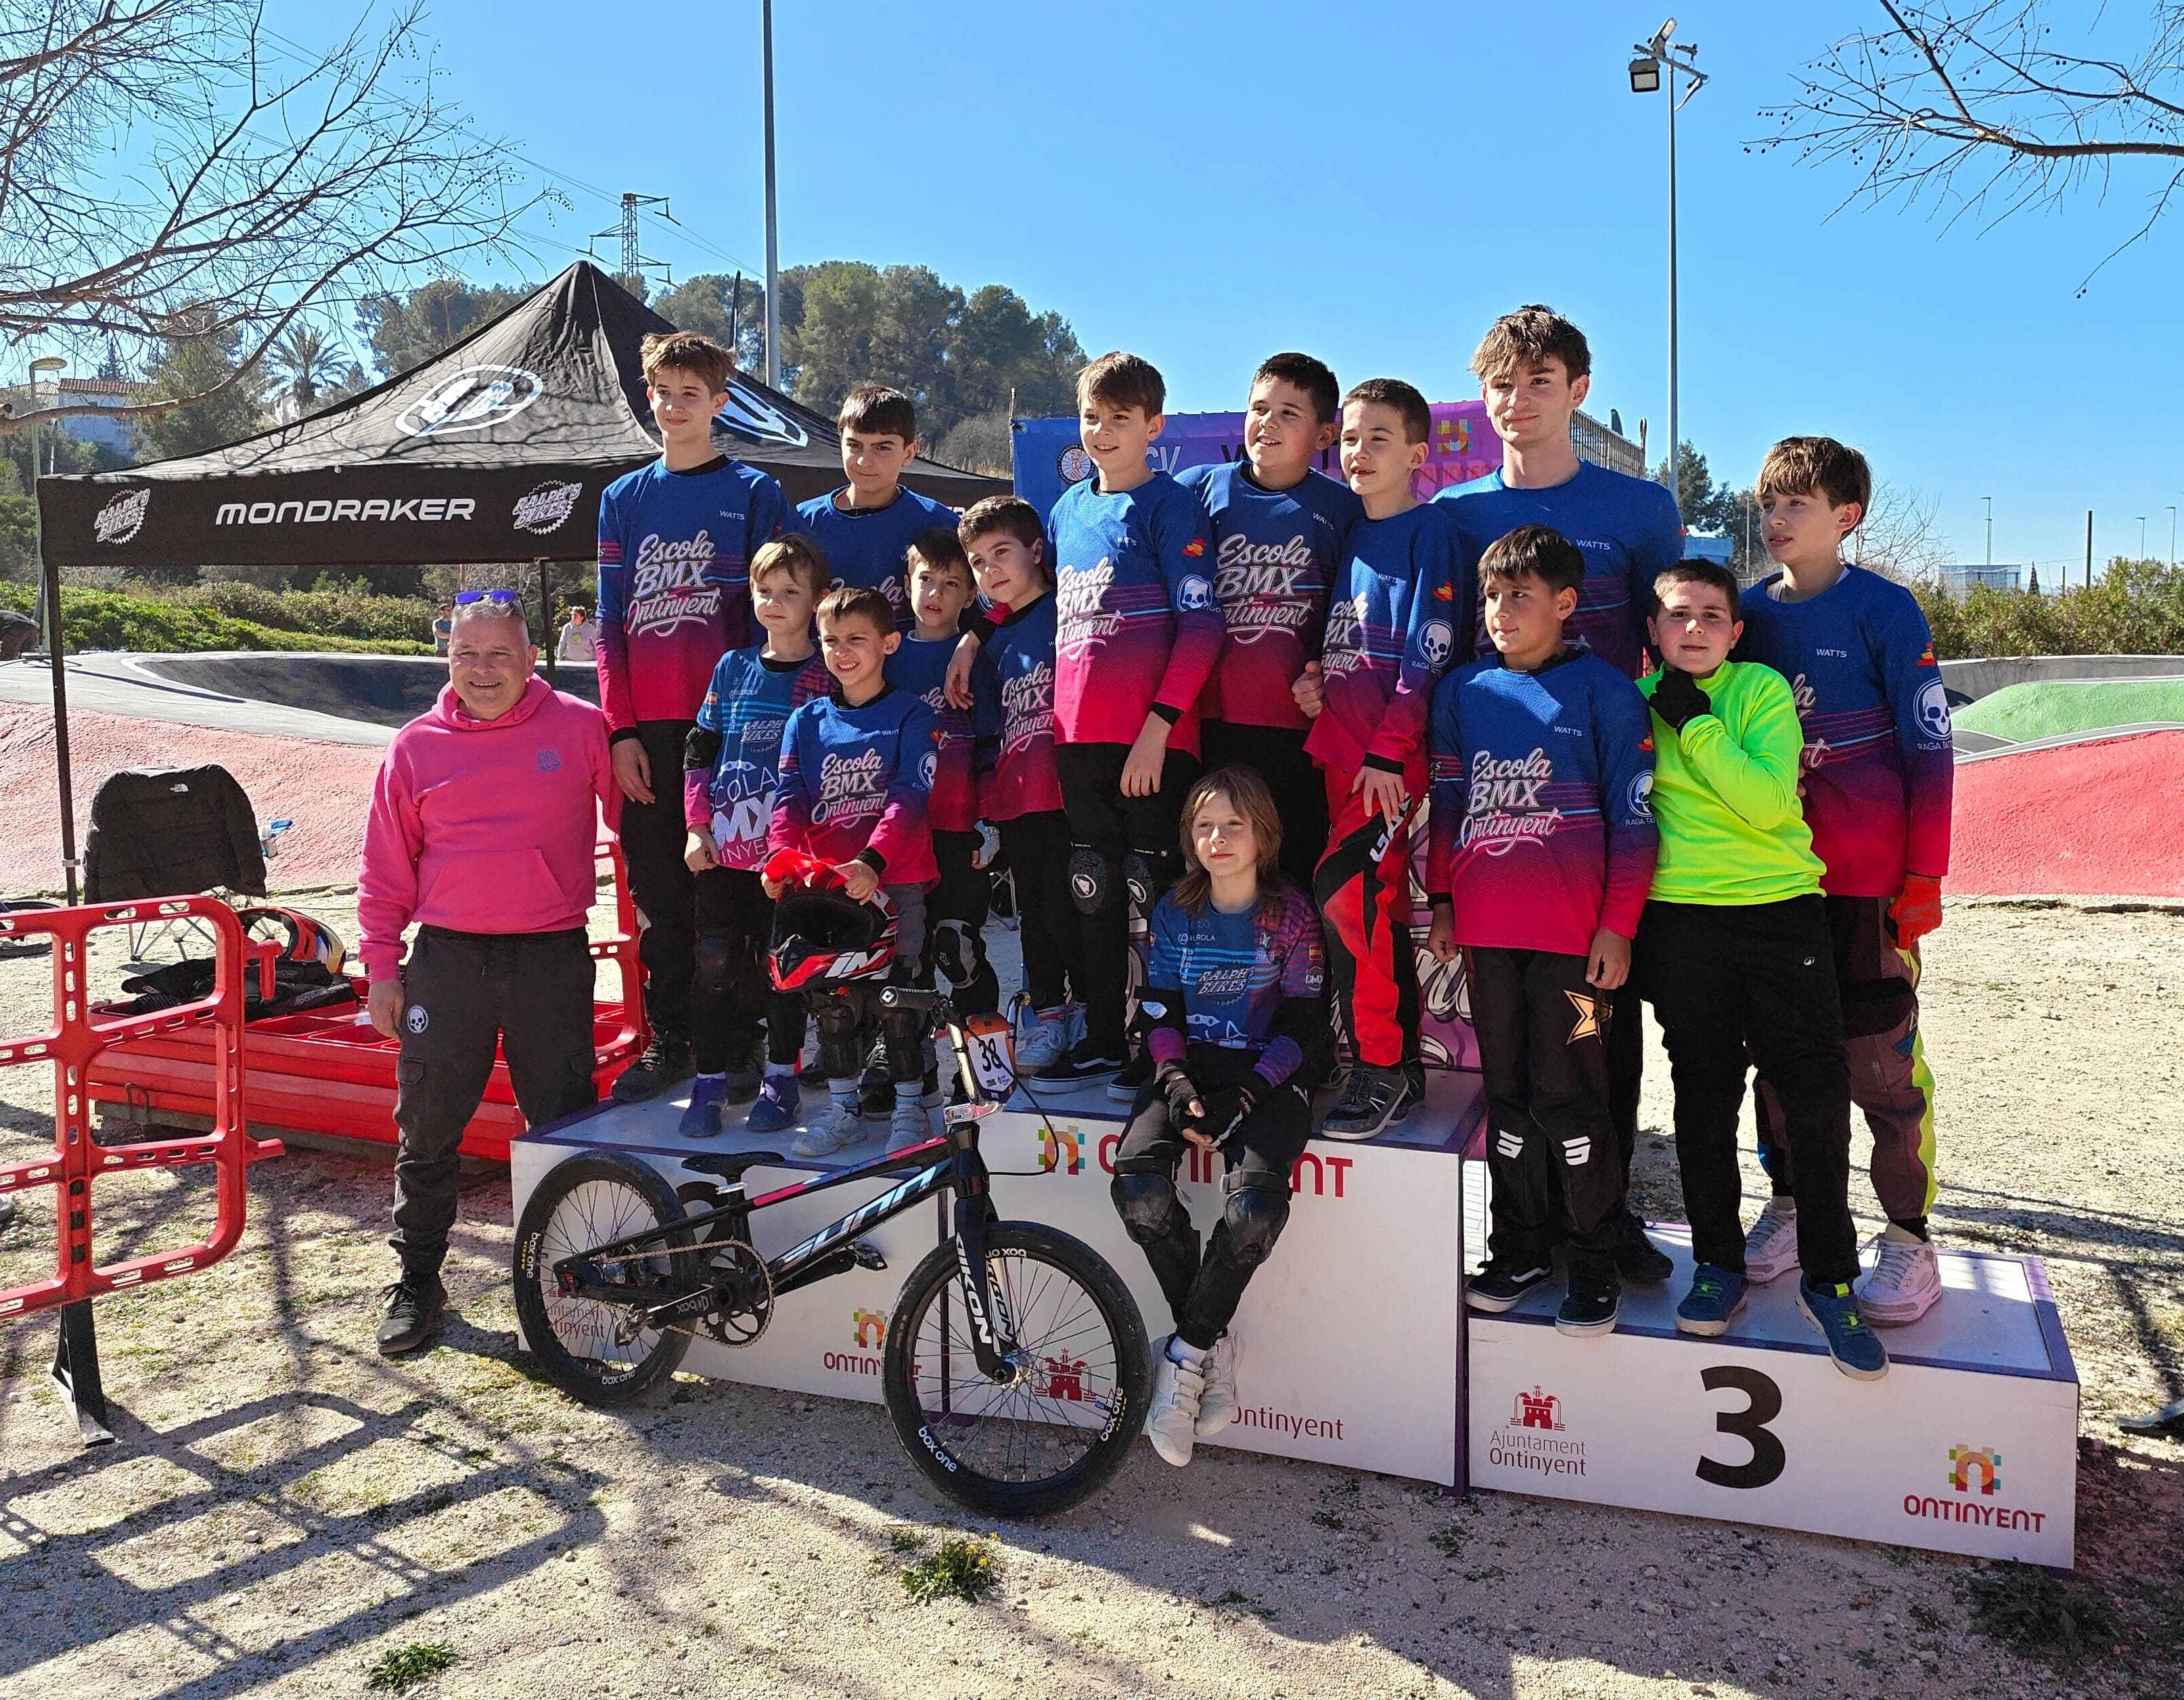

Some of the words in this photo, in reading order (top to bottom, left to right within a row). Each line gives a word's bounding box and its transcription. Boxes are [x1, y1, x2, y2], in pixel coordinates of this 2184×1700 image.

[215, 498, 476, 525] MONDRAKER
[512, 483, 583, 516] RALPH'S
[720, 510, 745, 520] WATTS
[514, 506, 570, 529] BIKES
[635, 529, 716, 570] Escola
[1216, 533, 1313, 569] Escola
[1576, 539, 1611, 551] WATTS
[633, 560, 711, 598] BMX
[1213, 565, 1307, 598] BMX
[627, 587, 722, 638] Ontinyent
[1055, 585, 1112, 619] BMX
[1816, 648, 1847, 658] WATTS
[1001, 661, 1054, 707] Escola
[1554, 725, 1583, 737] WATTS
[1917, 742, 1942, 751] RAGA
[820, 748, 884, 780] Escola
[1471, 747, 1553, 784] Escola
[819, 770, 882, 800] BMX
[1468, 780, 1550, 814] BMX
[811, 788, 889, 829] Ontinyent
[1625, 817, 1645, 826] RAGA
[1460, 807, 1564, 856] Ontinyent
[1196, 979, 1248, 996] BIKES
[978, 1037, 1002, 1072] 38
[528, 1232, 541, 1256] box
[1001, 1247, 1027, 1258] box
[526, 1256, 536, 1279] one
[601, 1374, 621, 1386] box
[620, 1368, 636, 1381] one
[1112, 1387, 1124, 1415] one
[1490, 1429, 1587, 1456] Ajuntament
[1696, 1366, 1786, 1489] 3
[918, 1425, 939, 1454] box
[935, 1450, 958, 1473] one
[1489, 1447, 1587, 1477] Ontinyent
[1903, 1494, 2046, 1534] ONTINYENT
